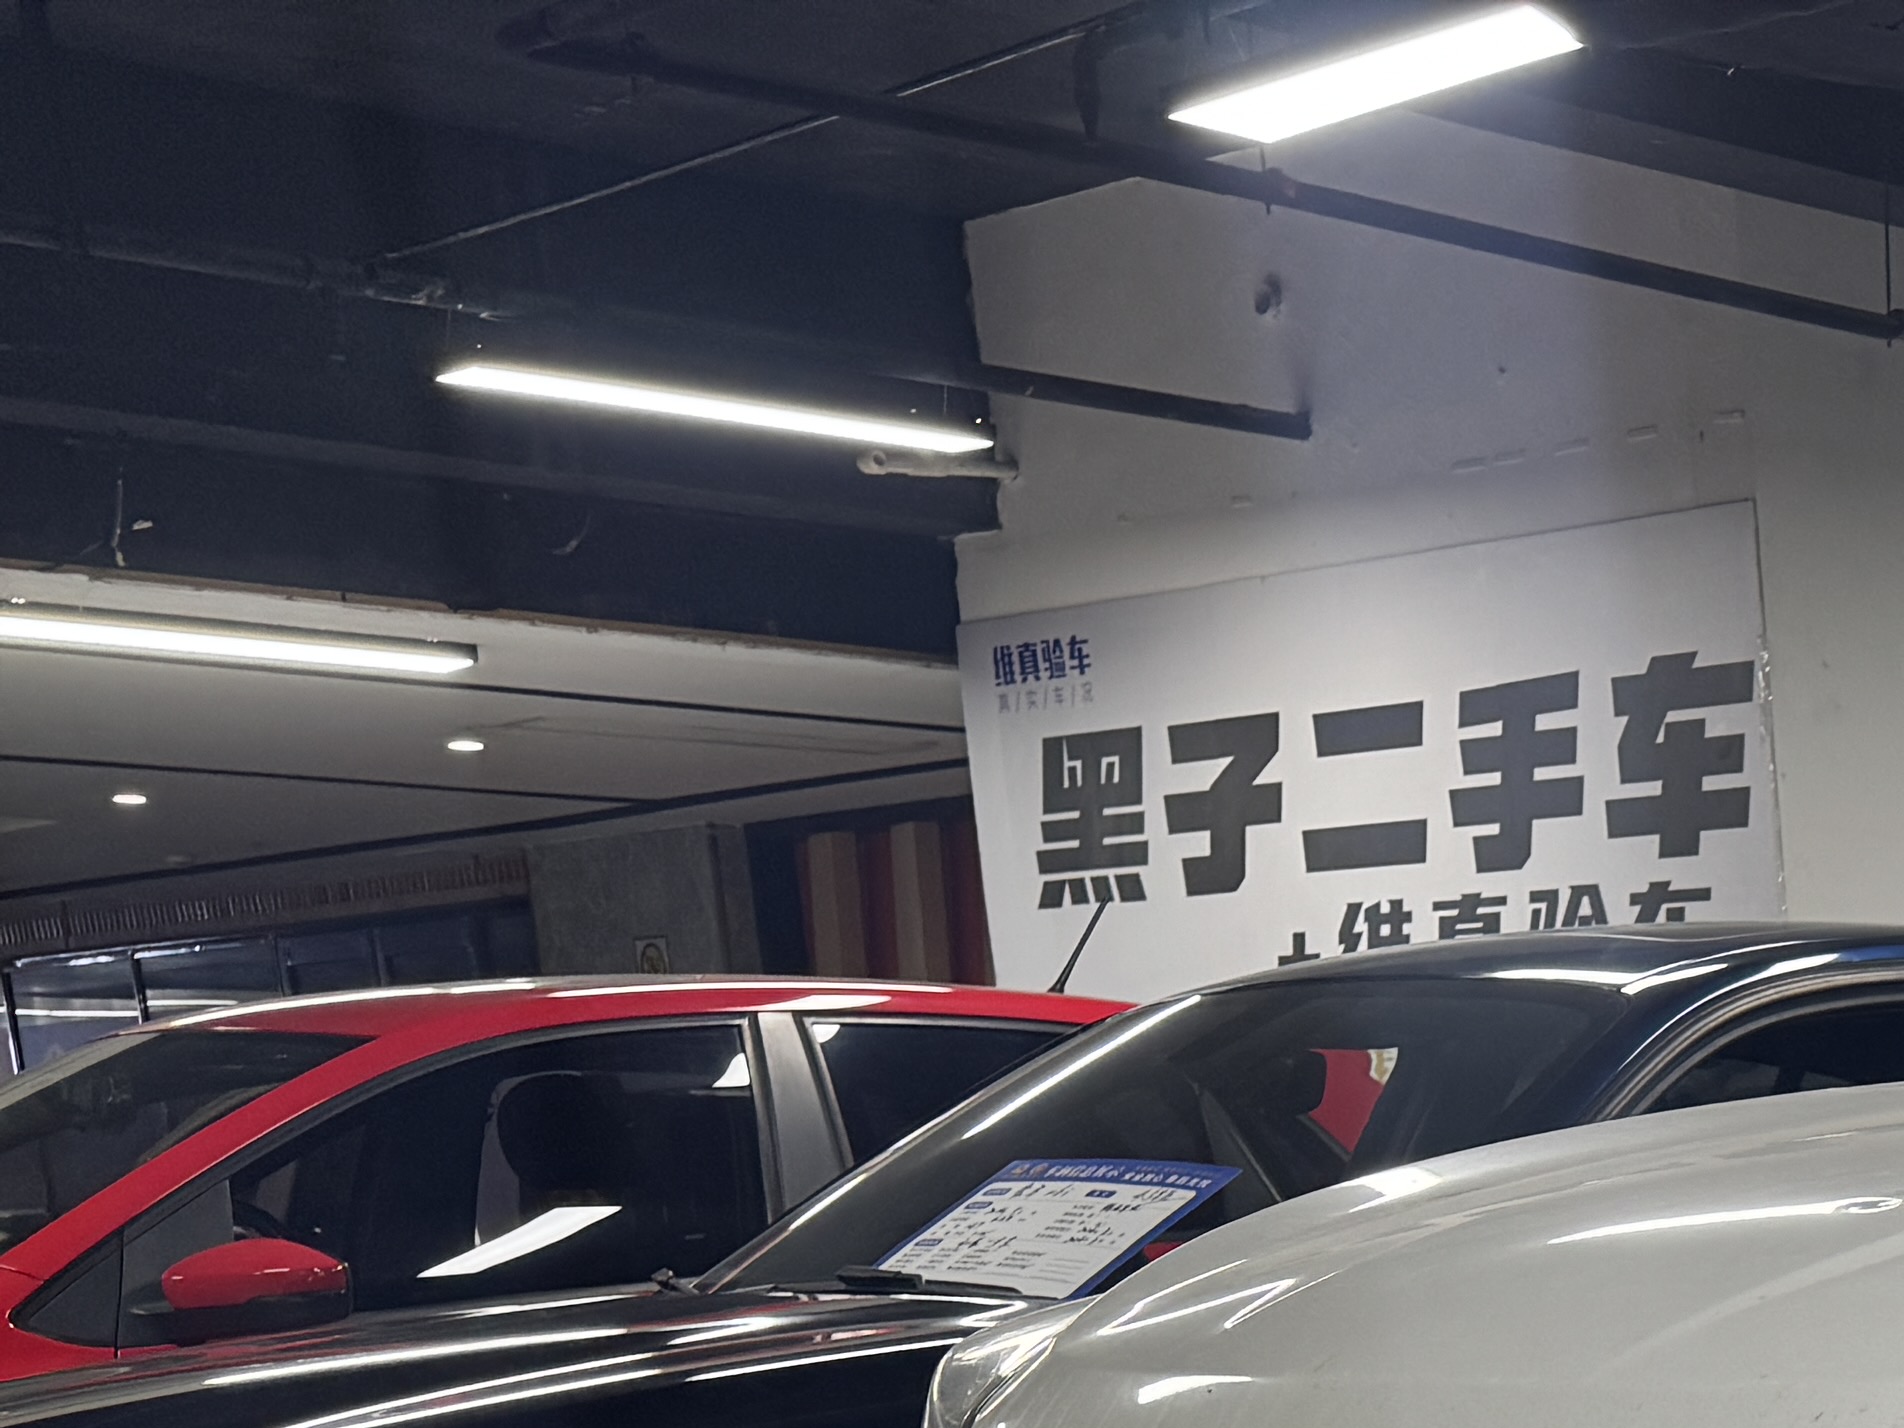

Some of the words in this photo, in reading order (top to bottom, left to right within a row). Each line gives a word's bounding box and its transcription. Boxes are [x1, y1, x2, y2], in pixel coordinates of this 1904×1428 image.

[993, 635, 1091, 687] 维真验车
[1037, 651, 1754, 910] 黑子二手车
